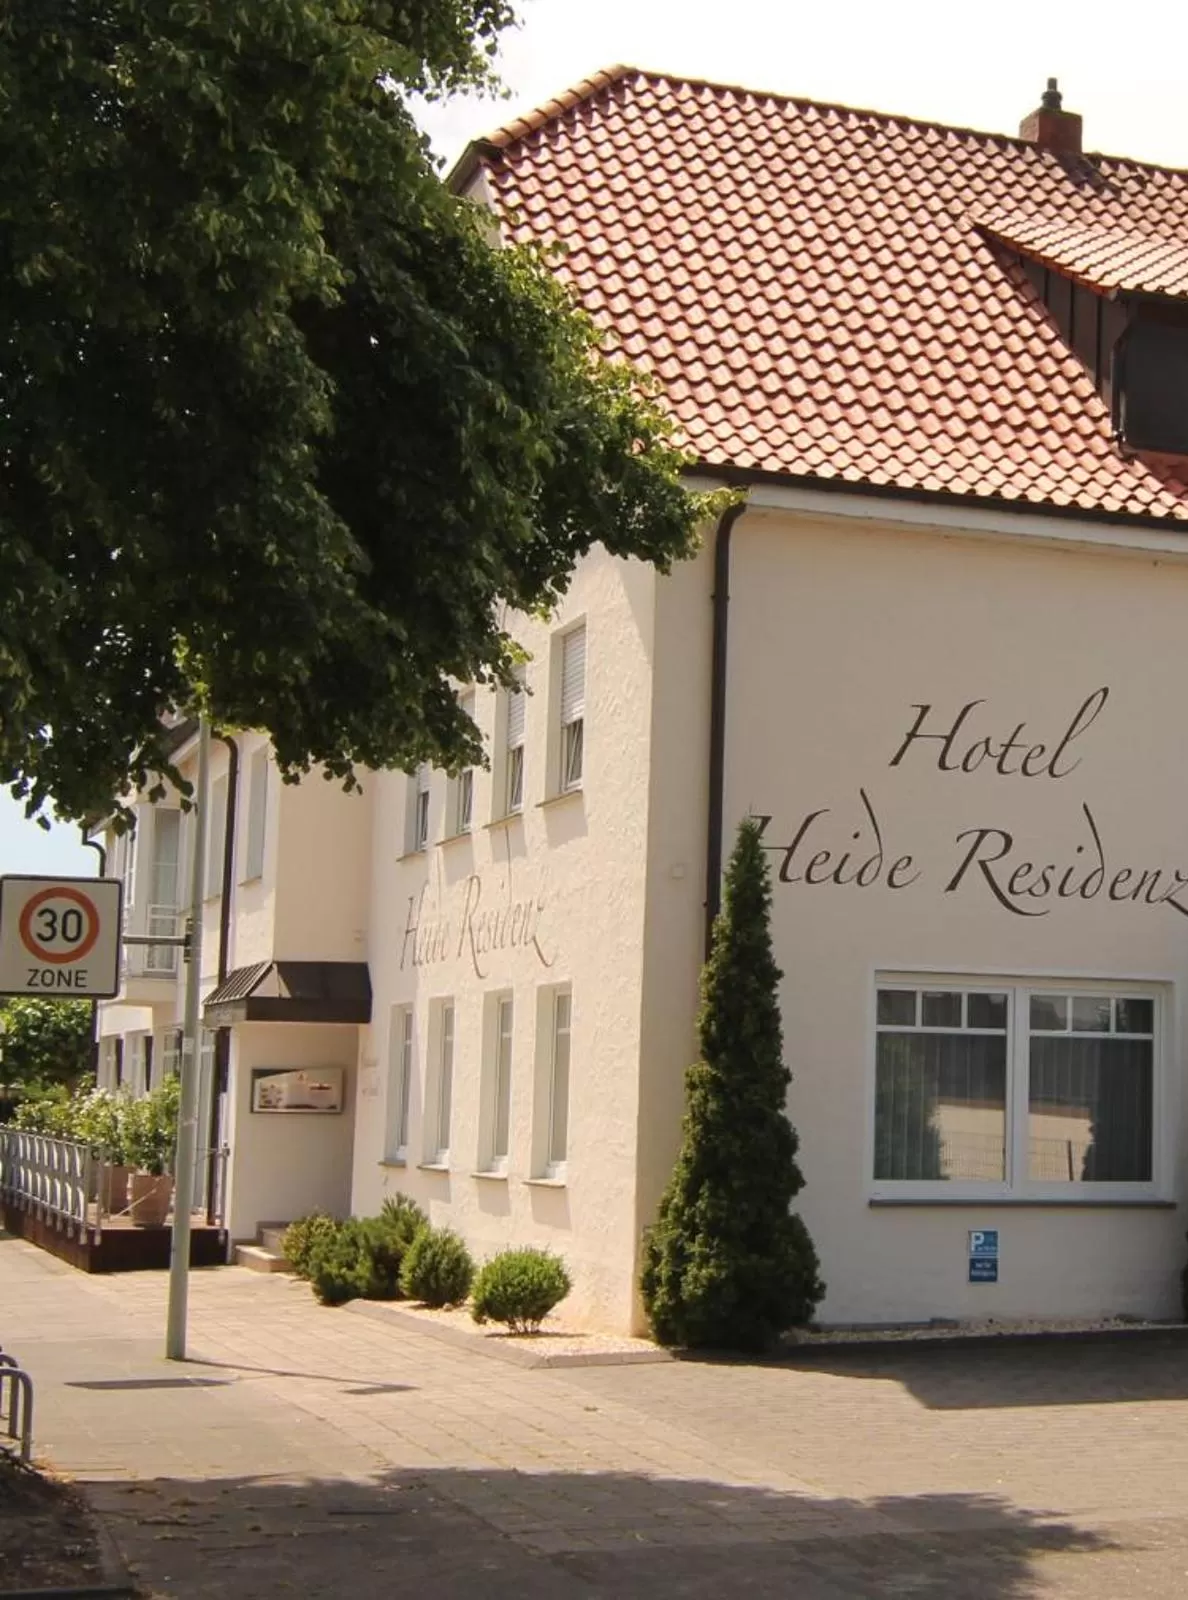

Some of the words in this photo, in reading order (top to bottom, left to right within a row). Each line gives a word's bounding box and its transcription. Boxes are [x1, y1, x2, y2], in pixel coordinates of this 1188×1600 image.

[888, 686, 1110, 779] Hotel
[749, 787, 921, 890] Heide
[36, 907, 83, 943] 30
[26, 968, 88, 988] ZONE
